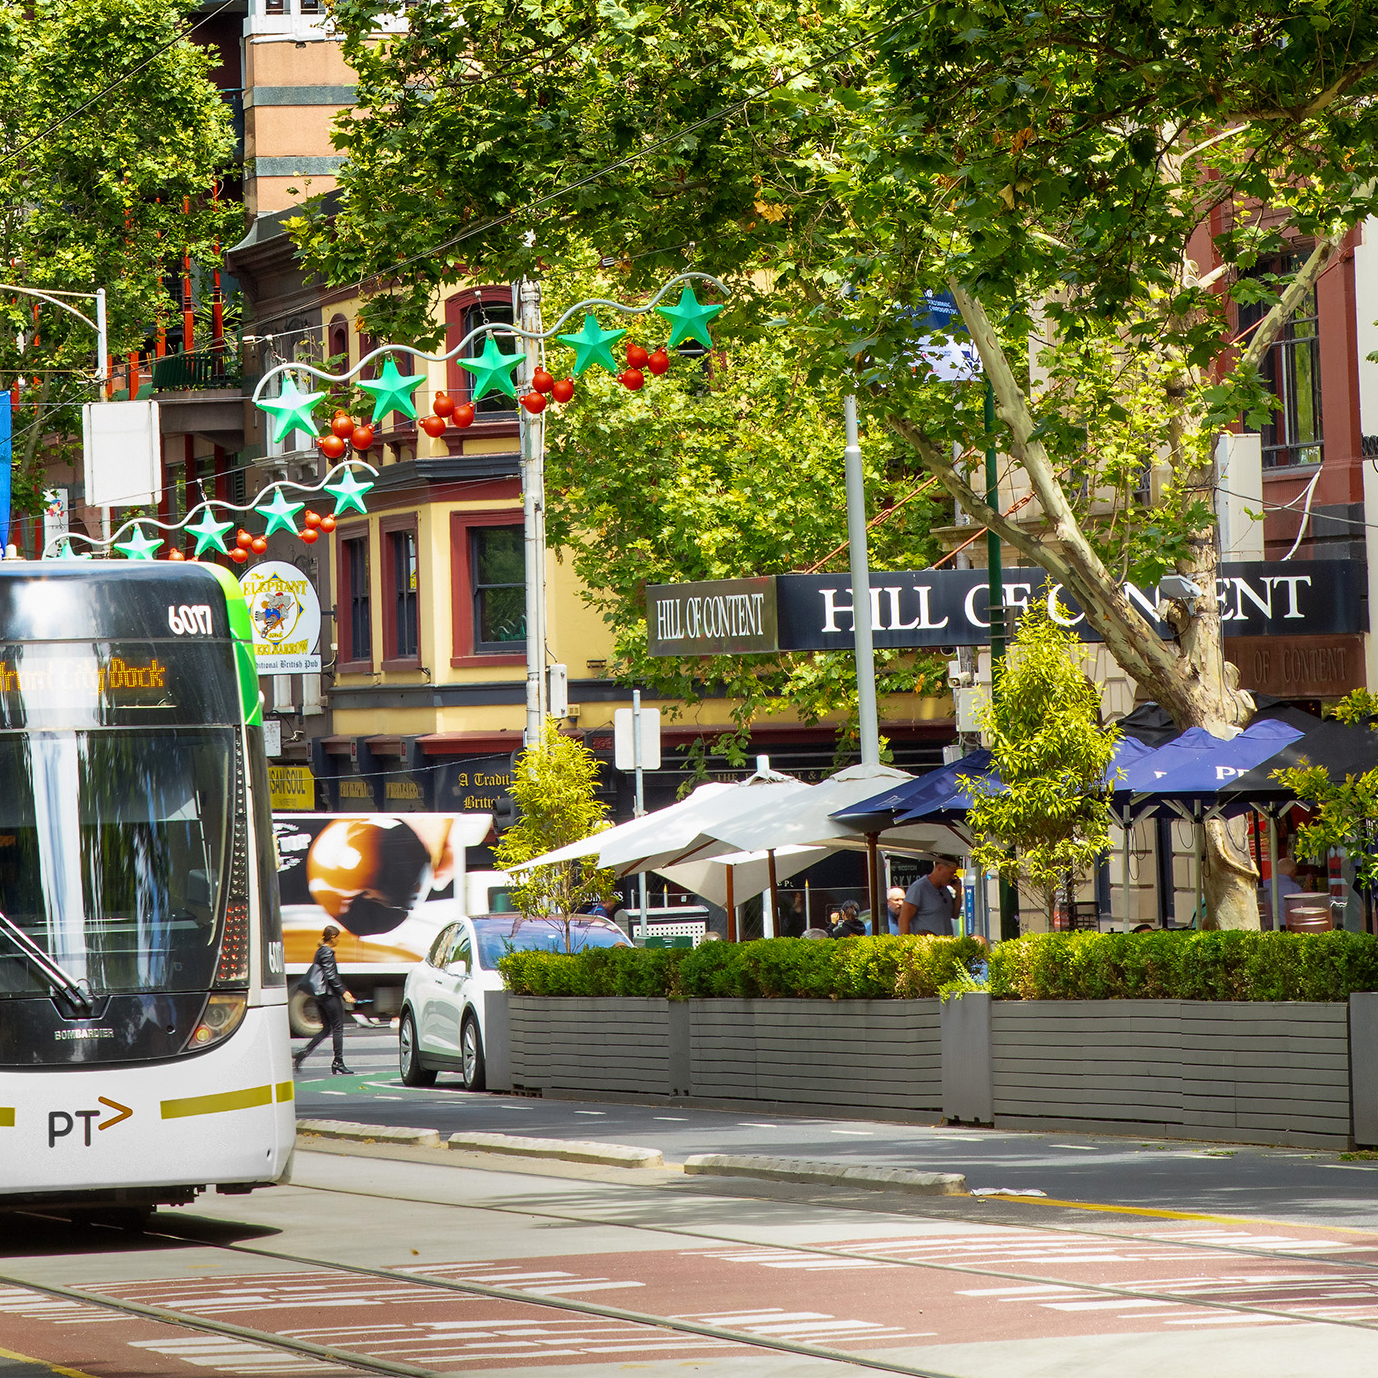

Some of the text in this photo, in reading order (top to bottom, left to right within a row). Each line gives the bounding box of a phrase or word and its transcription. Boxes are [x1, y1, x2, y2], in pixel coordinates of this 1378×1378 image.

[243, 580, 308, 597] ELEPHANT
[168, 605, 213, 635] 6017
[656, 593, 764, 640] HILL OF CONTENT
[818, 585, 949, 633] HILL
[305, 660, 319, 669] Pub
[1254, 650, 1271, 684] OF
[1283, 647, 1347, 683] CONTENT
[286, 769, 306, 795] SOUL
[458, 772, 510, 786] A Tradit
[54, 1028, 114, 1040] BOMBARDIER
